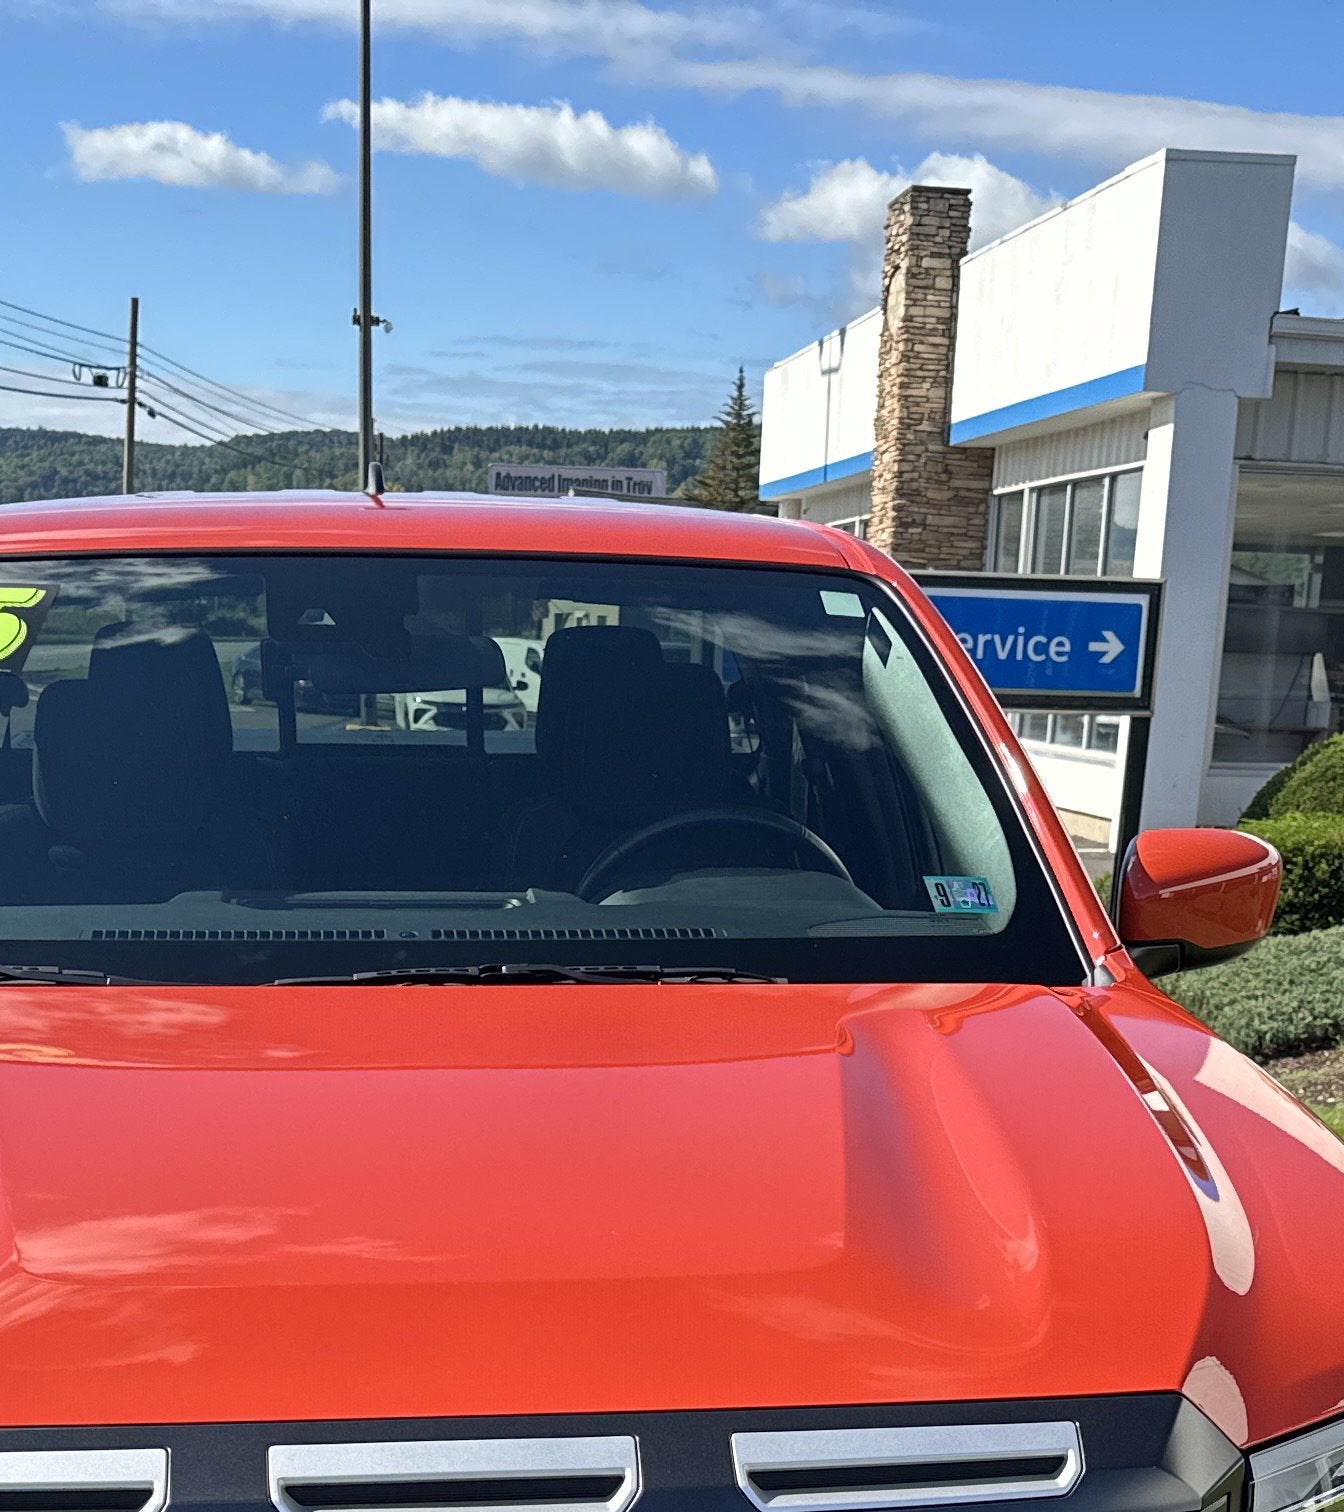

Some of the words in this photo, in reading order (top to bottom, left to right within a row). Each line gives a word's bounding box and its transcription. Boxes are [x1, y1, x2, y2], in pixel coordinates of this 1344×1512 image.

[494, 471, 555, 493] Advanced
[611, 475, 623, 492] in
[625, 476, 654, 495] Troy
[956, 626, 1072, 663] ervice
[934, 882, 952, 908] 9
[971, 881, 994, 909] 27
